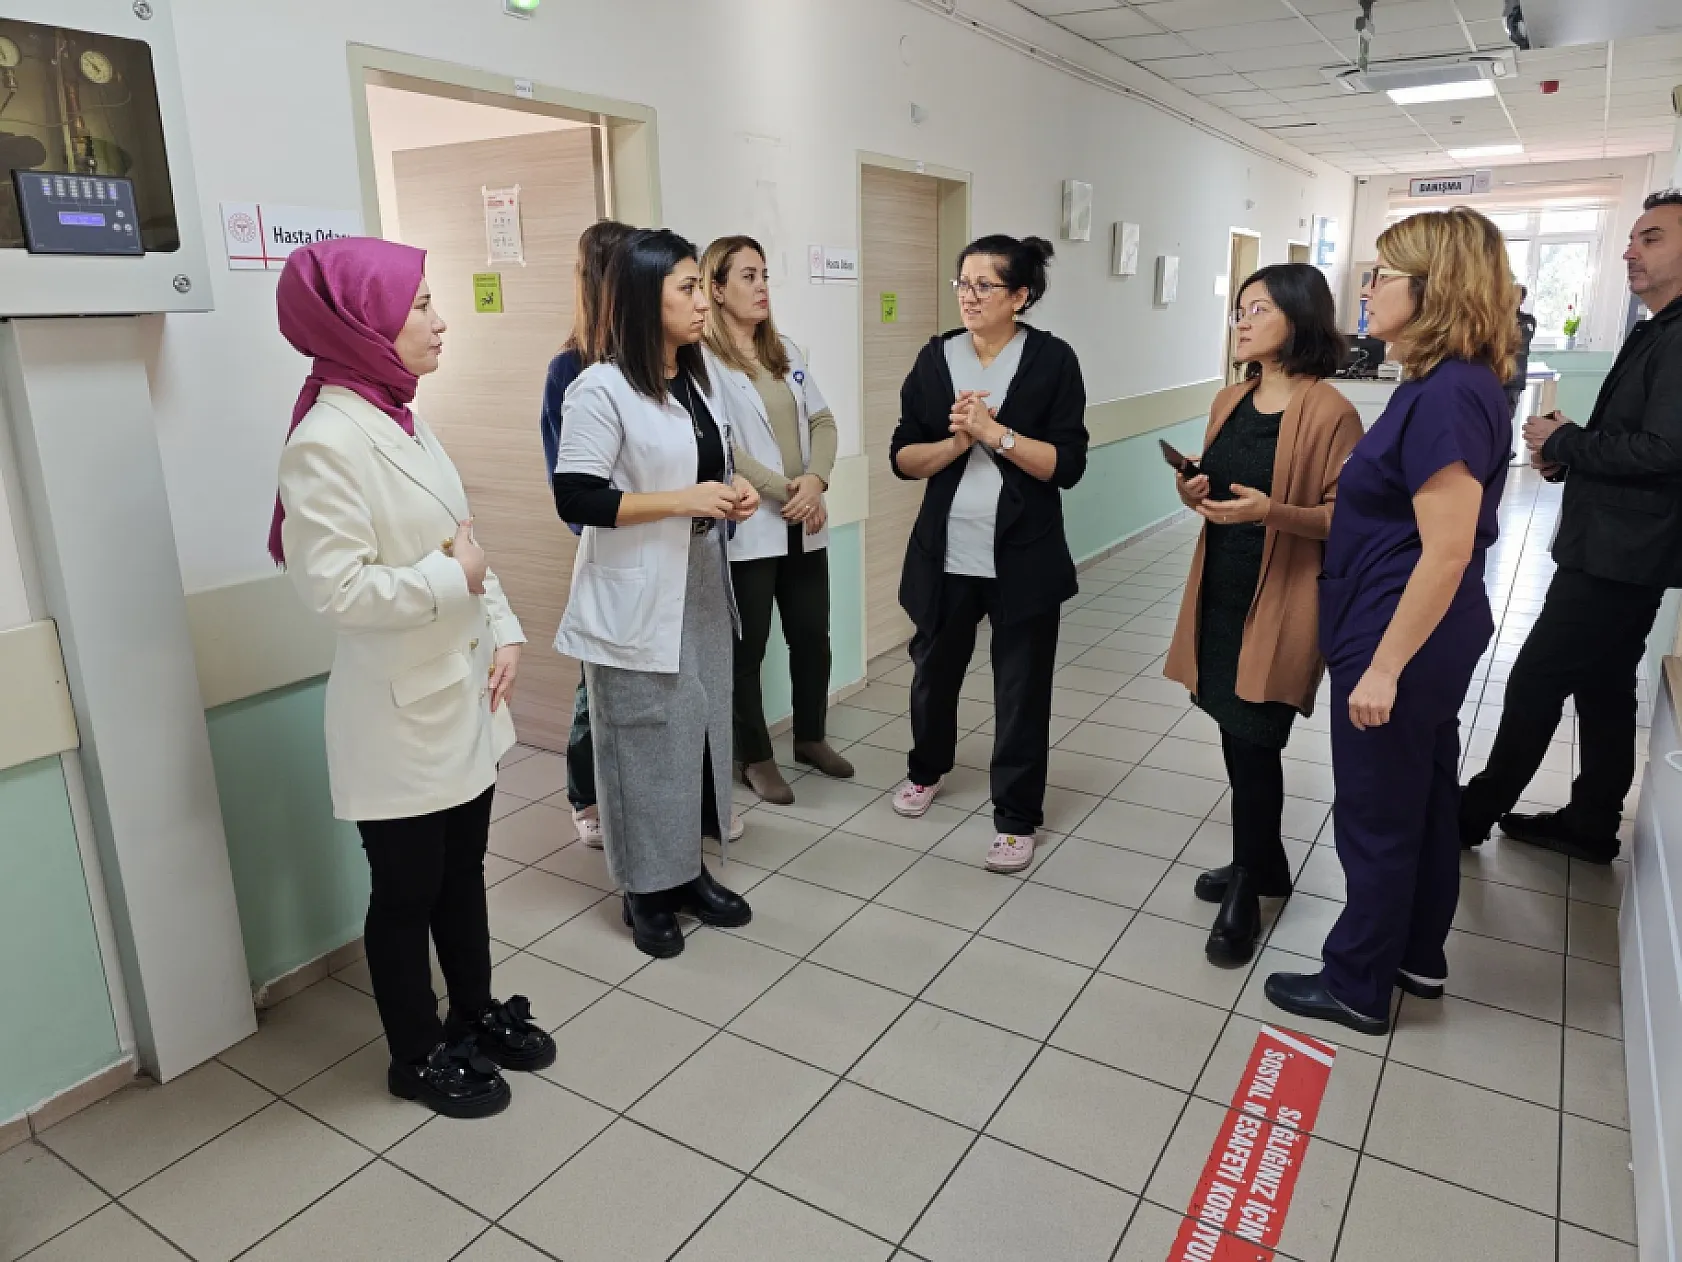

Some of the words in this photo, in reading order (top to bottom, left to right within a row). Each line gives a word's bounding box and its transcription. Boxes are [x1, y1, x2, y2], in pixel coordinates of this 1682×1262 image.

[1419, 181, 1462, 193] DANIŞMA
[273, 226, 312, 244] Hasta
[1248, 1048, 1287, 1099] SOSYAL
[1217, 1101, 1267, 1184] MESAFEYİ
[1236, 1199, 1278, 1244] İÇİN
